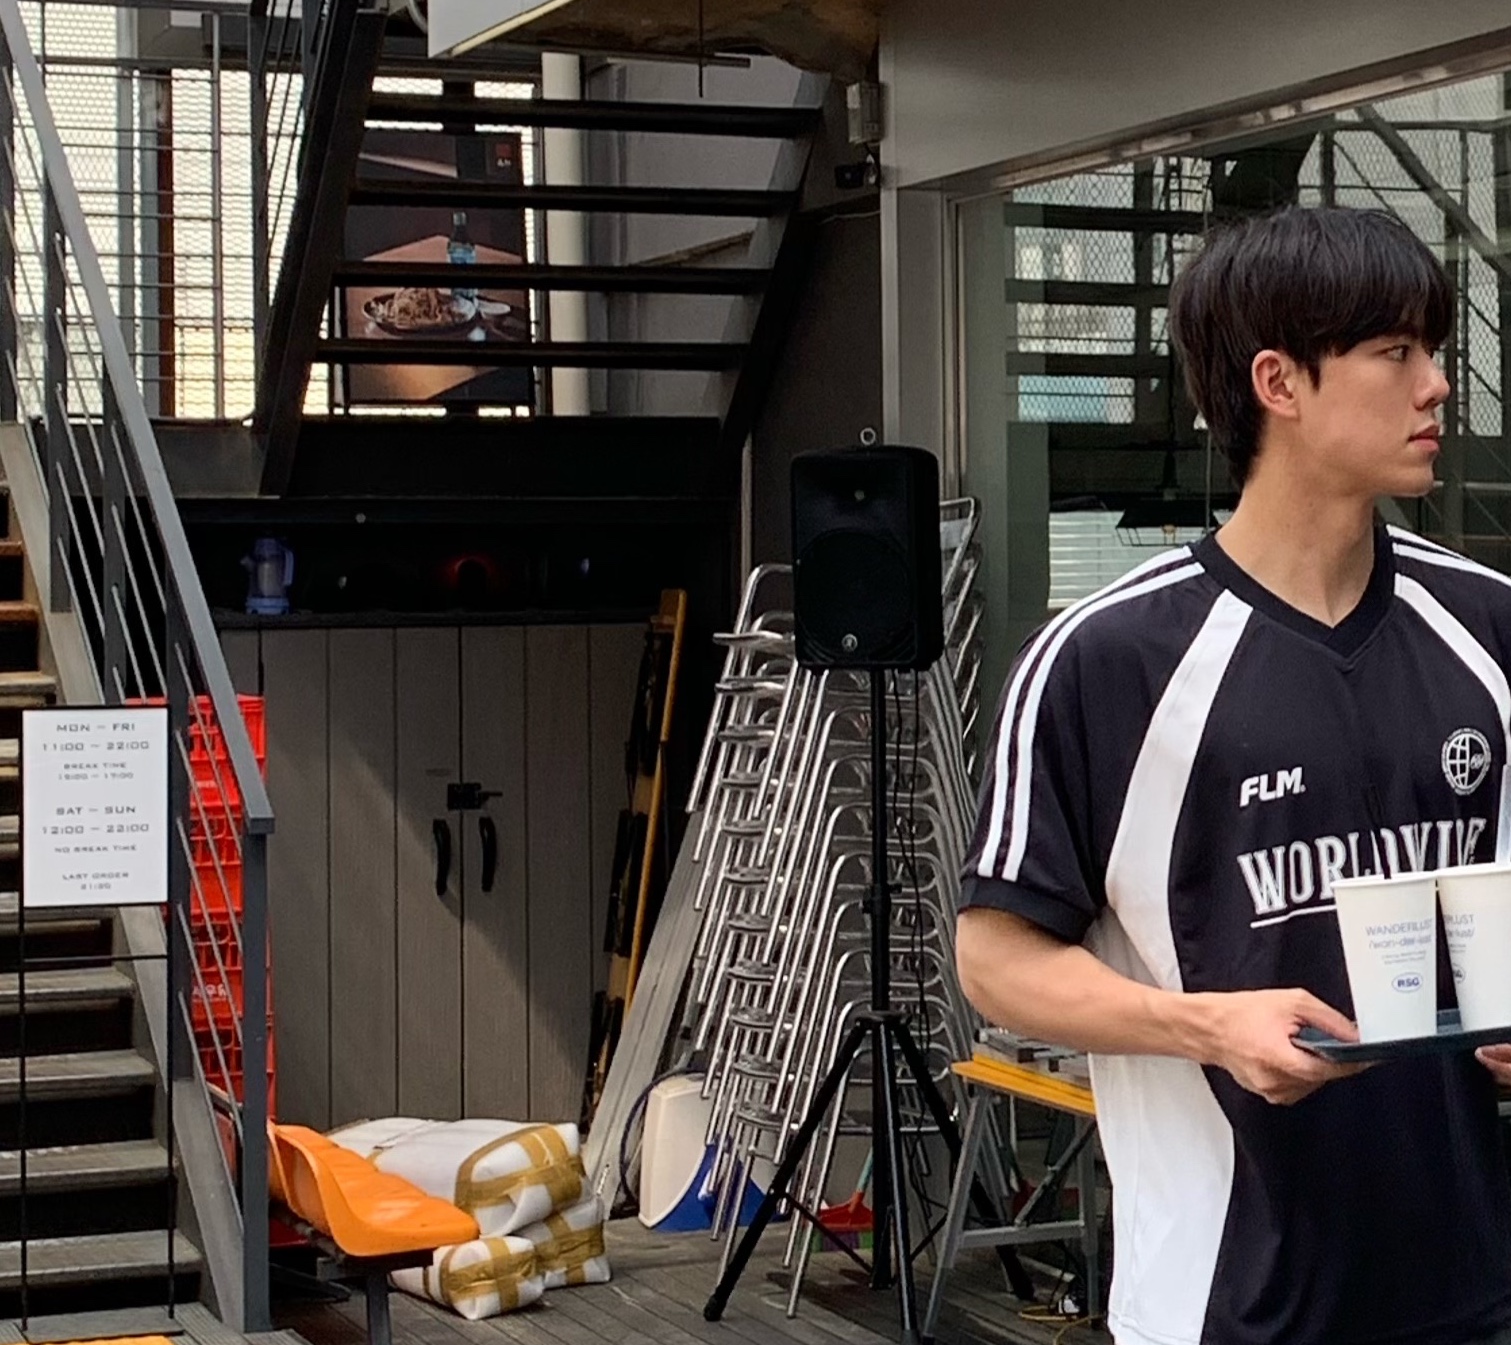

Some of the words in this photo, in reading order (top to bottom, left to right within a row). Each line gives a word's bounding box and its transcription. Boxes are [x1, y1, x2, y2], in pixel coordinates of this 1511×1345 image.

[56, 723, 91, 732] MON
[112, 722, 135, 732] FRI
[43, 742, 84, 751] 11:00
[106, 741, 149, 750] 22:00
[56, 807, 83, 816] SAT
[104, 806, 136, 815] SUN
[42, 825, 84, 835] 12:00
[1397, 977, 1420, 988] RSG
